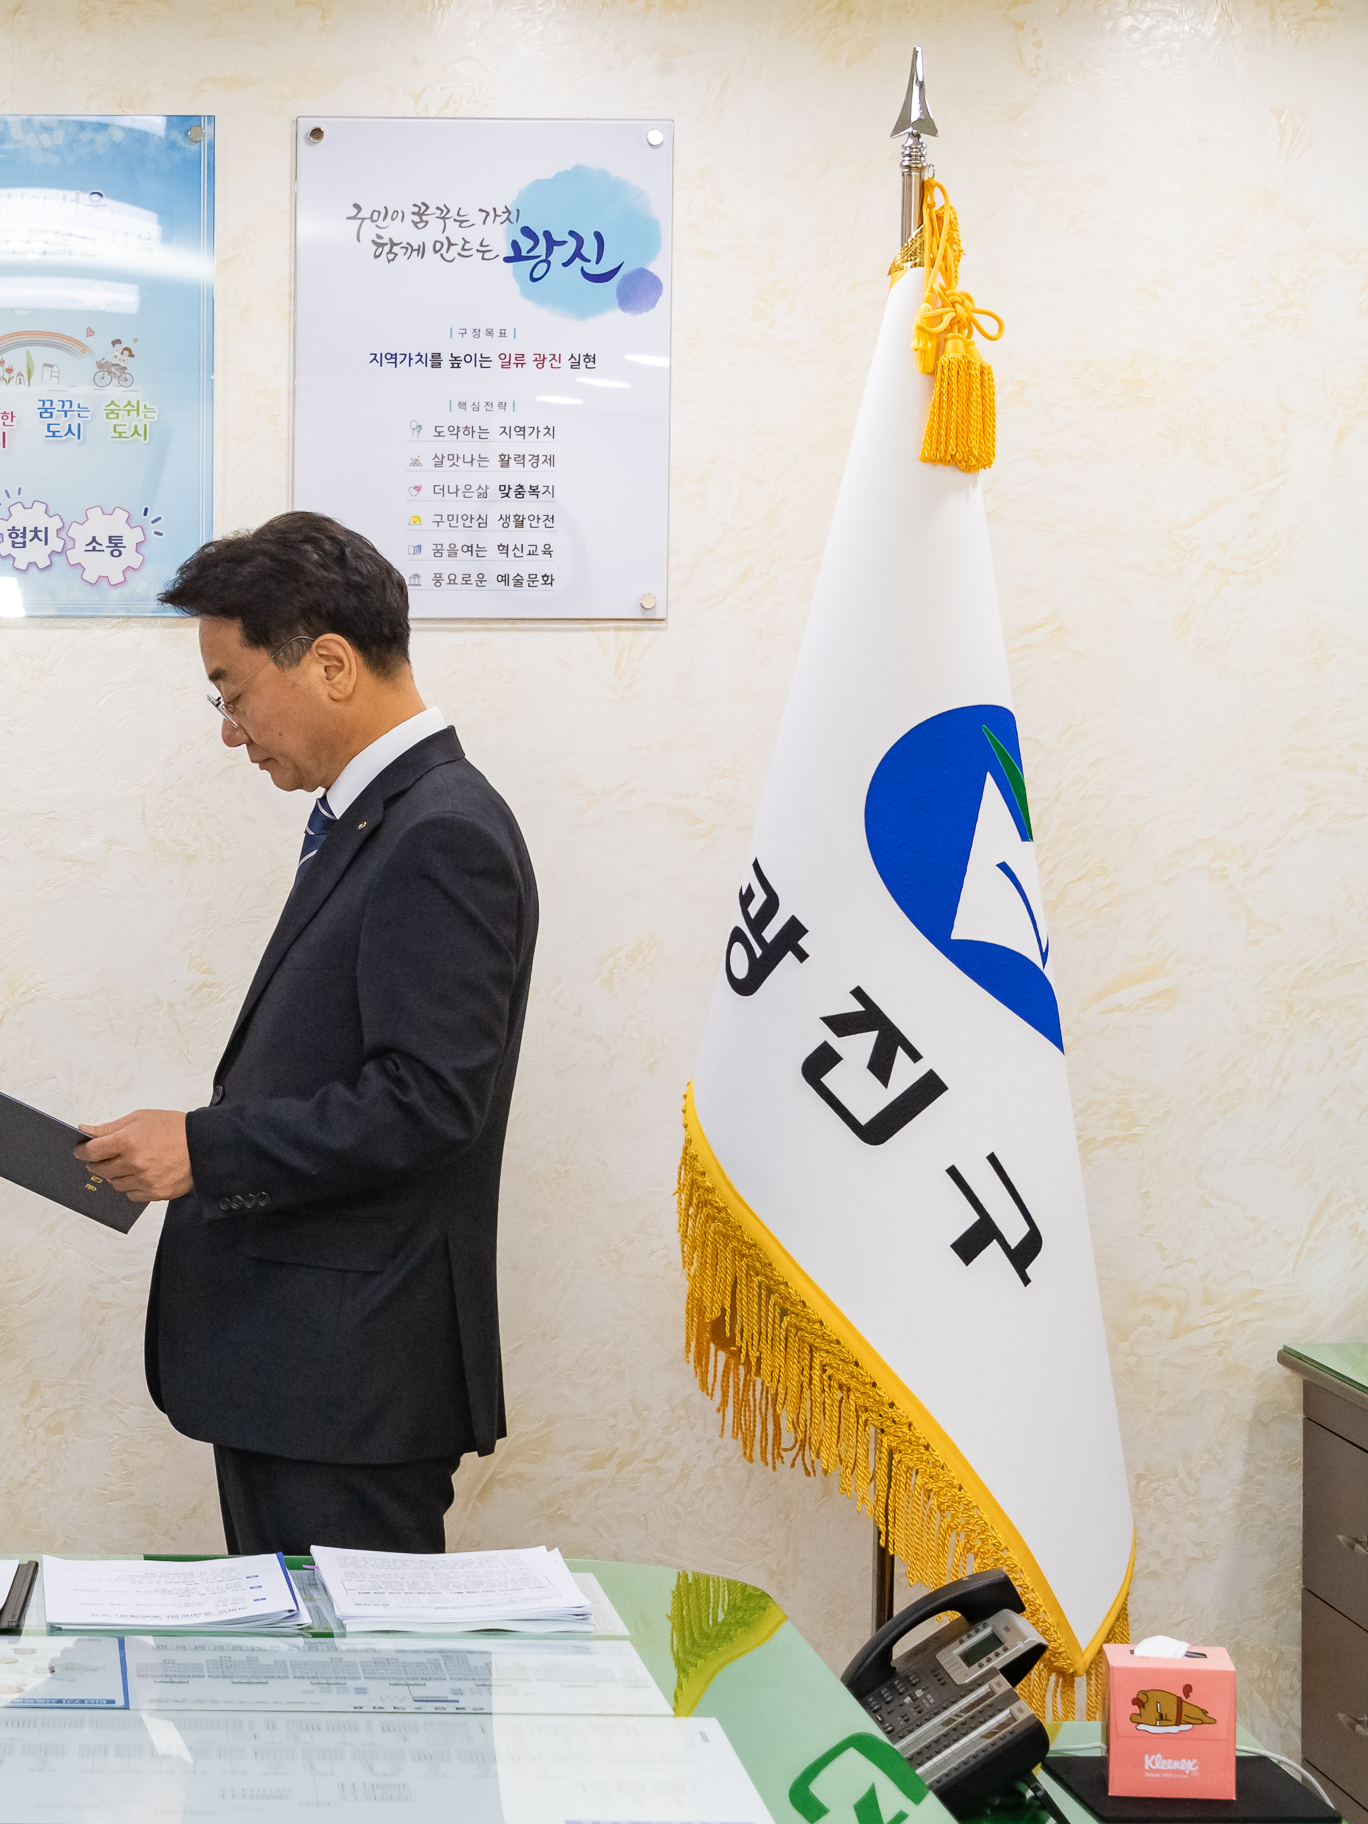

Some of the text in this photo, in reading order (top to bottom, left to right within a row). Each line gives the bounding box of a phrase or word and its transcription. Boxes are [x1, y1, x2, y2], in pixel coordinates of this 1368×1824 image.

[346, 201, 520, 243] 구민이 꿈꾸는 가치
[372, 225, 625, 284] 함께 만드는 광진
[458, 327, 508, 339] 구정목표
[369, 352, 597, 369] 지역가치를 높이는 일류 광진 실현
[37, 399, 90, 420] 꿈꾸는
[104, 400, 157, 421] 숨쉬는
[44, 423, 82, 440] 도시
[110, 423, 148, 442] 도시
[433, 425, 556, 440] 도약하는 지역가치
[432, 454, 556, 468] 살맛나는 활력경제
[433, 484, 556, 499] 더나은삶 맞춤복지
[432, 514, 555, 529] 구민안심 생활안전
[7, 526, 49, 549] 협치
[84, 535, 127, 558] 소통
[432, 543, 554, 558] 꿈을여는 혁신교육
[432, 573, 555, 587] 풍요로운 예술문화
[1144, 1753, 1199, 1774] Kleenex
